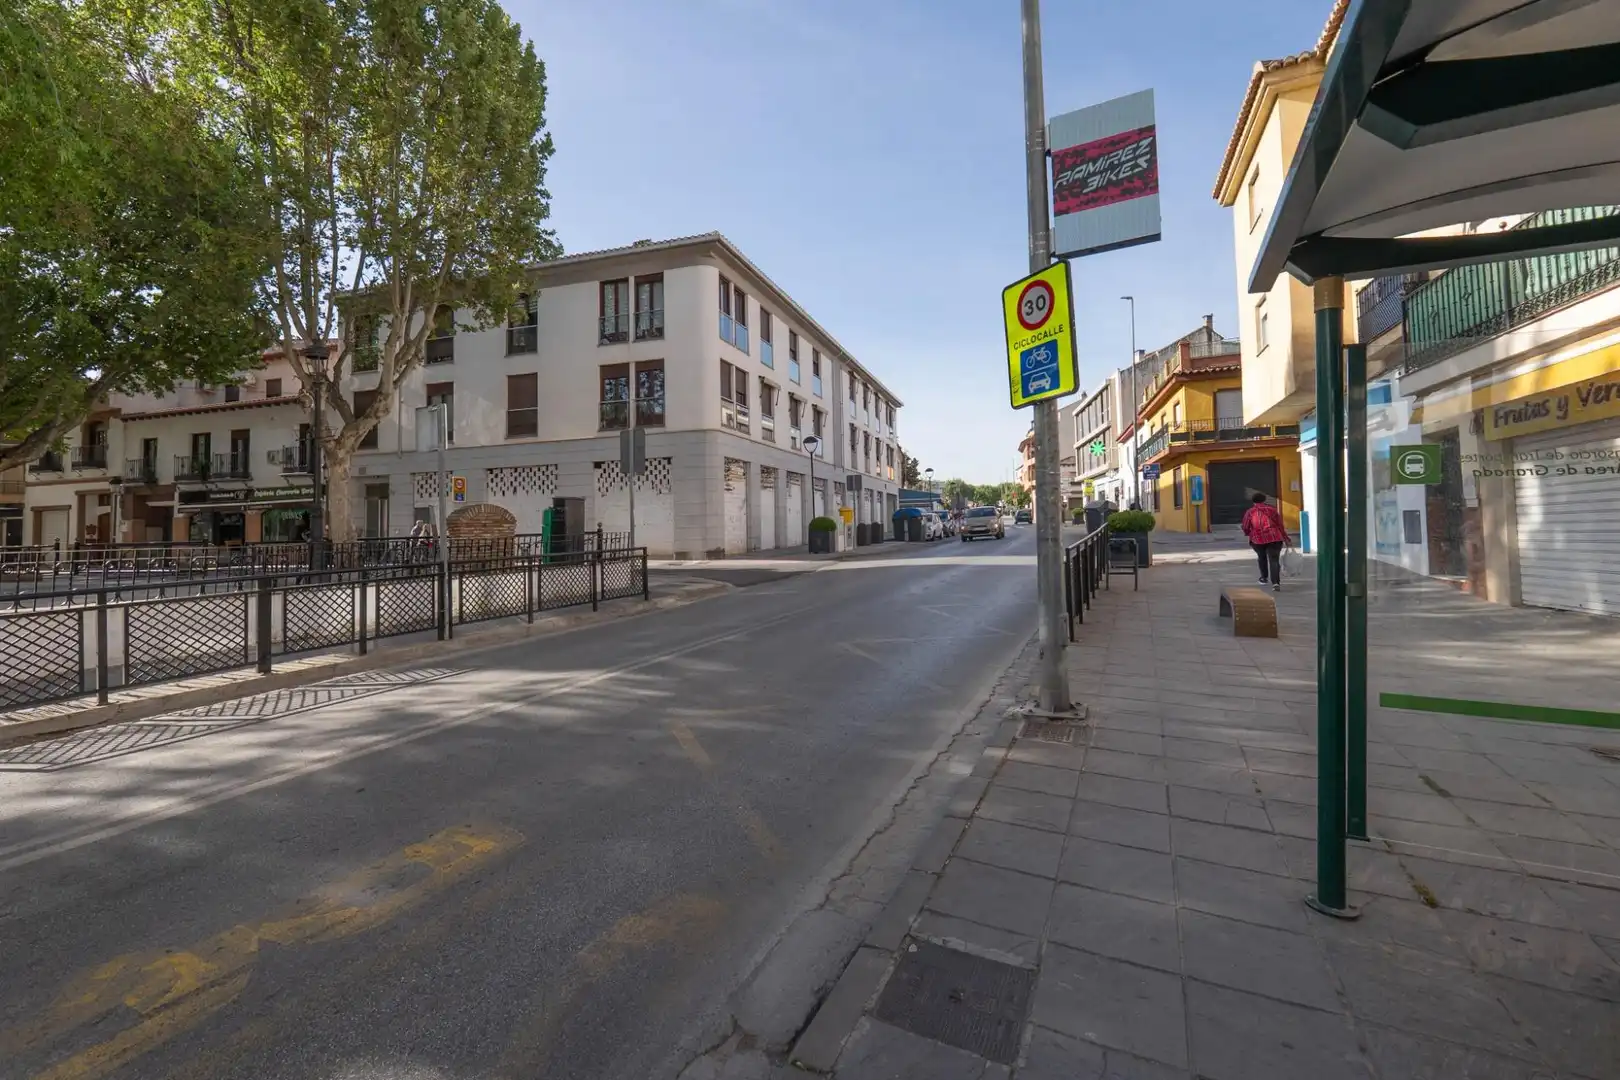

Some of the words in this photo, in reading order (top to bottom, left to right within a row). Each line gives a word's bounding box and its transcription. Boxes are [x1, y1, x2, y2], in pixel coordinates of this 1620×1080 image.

[1055, 136, 1154, 189] RAMIREZ
[1082, 154, 1151, 193] BIKES
[1024, 294, 1046, 316] 30
[1013, 324, 1065, 351] CICLOCALLE
[1493, 399, 1550, 428] Frutas
[1556, 394, 1570, 420] y
